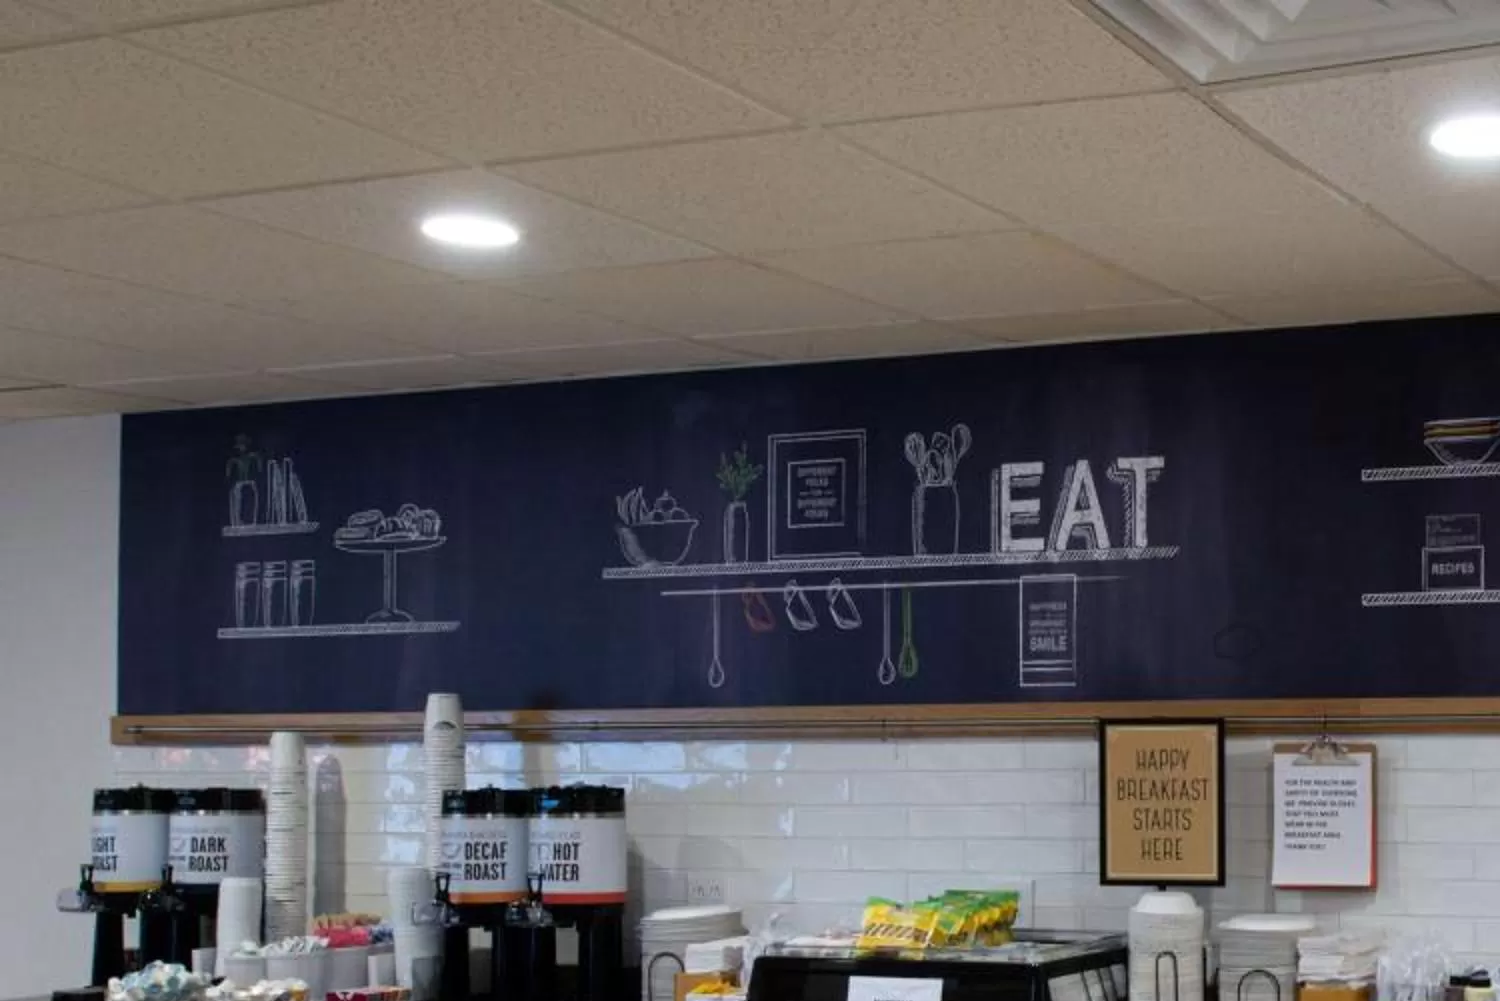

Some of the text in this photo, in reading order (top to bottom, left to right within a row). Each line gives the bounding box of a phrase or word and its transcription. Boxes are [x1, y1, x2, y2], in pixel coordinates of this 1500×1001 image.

[992, 456, 1164, 553] EAT
[1431, 562, 1475, 576] RECIPES
[1135, 748, 1190, 771] HAPPY
[1116, 776, 1210, 801] BREAKFAST
[1133, 808, 1192, 831] STARTS
[190, 837, 226, 853] DARK
[464, 841, 509, 860] DECAF
[553, 841, 580, 860] HOT
[1140, 837, 1184, 861] HERE
[188, 855, 229, 872] ROAST
[464, 863, 509, 881] ROAST
[540, 863, 580, 881] WATER
